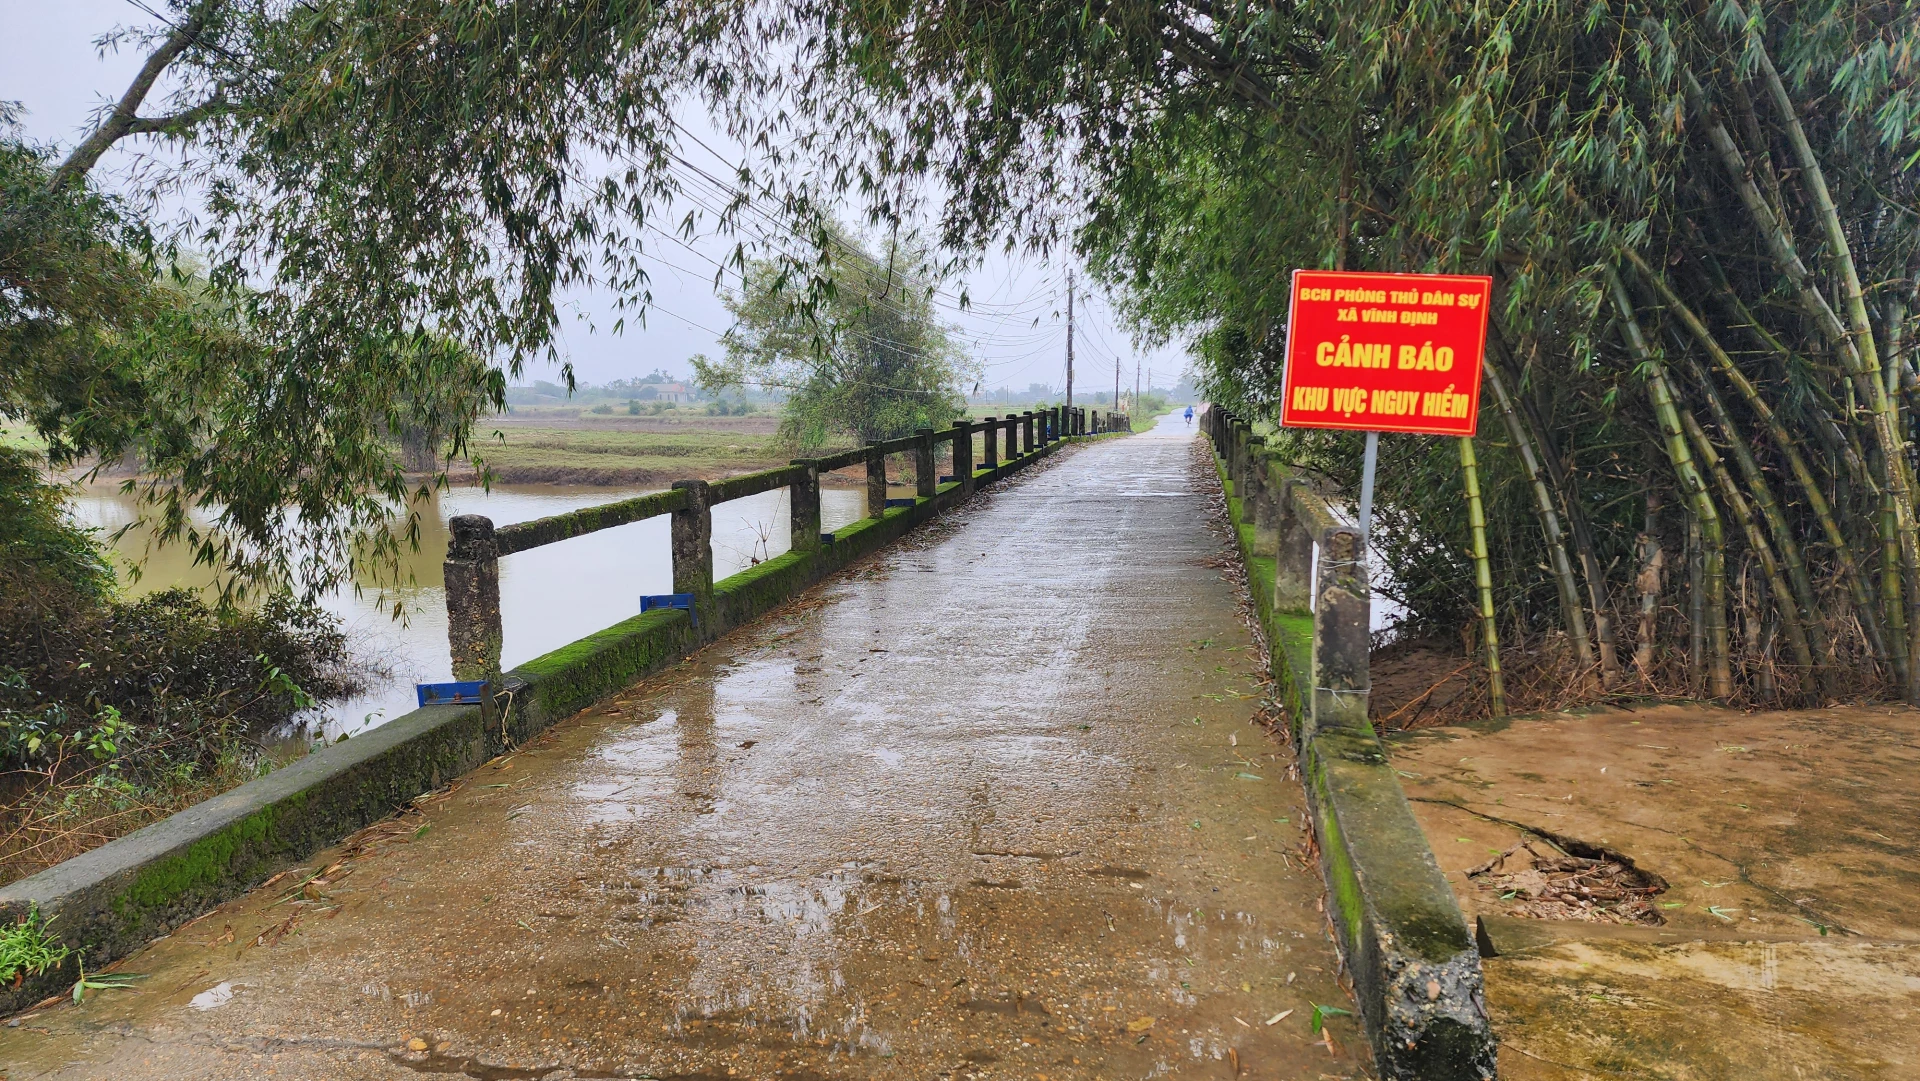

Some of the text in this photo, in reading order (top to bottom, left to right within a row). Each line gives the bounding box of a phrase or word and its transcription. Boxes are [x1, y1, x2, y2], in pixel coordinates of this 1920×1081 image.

[1300, 287, 1481, 309] BCH PHÒNG THỦ DÂN SỰ
[1337, 307, 1438, 326] XÃ VĨNH ĐỊNH
[1316, 335, 1454, 371] CẢNH BÁO
[1292, 384, 1469, 418] KHU VỰC NGUY HIỂM
